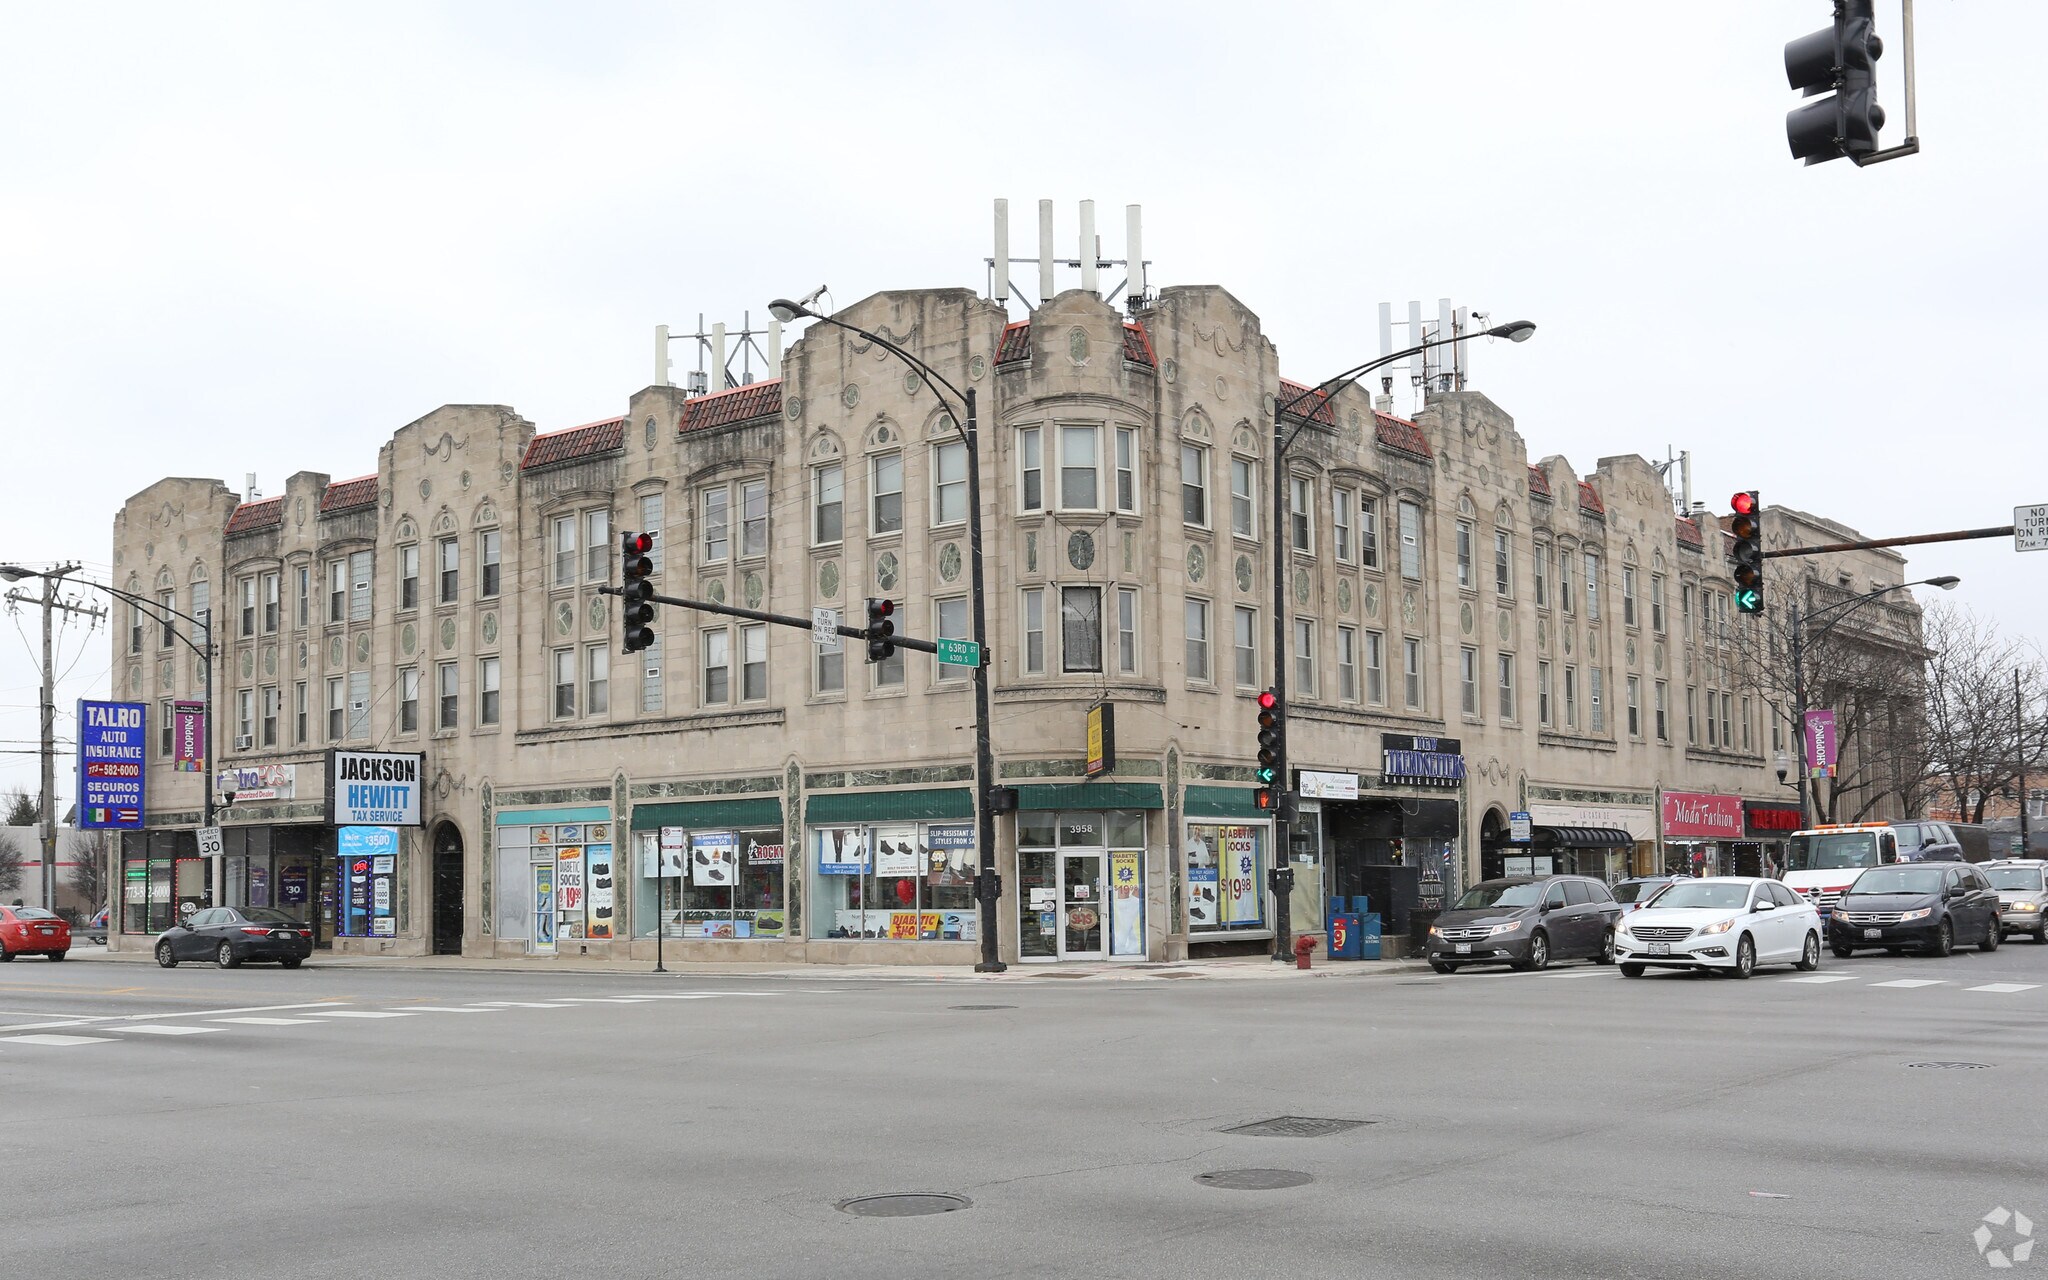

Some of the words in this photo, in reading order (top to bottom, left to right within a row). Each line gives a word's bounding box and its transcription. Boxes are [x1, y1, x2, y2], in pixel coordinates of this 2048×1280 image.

[2030, 508, 2045, 517] NO
[2018, 528, 2033, 538] ON
[820, 610, 829, 618] NO
[817, 617, 832, 626] TURN
[813, 624, 823, 633] ON
[824, 626, 835, 635] RED
[948, 643, 967, 654] 63RD
[970, 645, 977, 653] ST
[950, 653, 962, 662] 6300
[964, 655, 969, 663] S
[87, 706, 141, 729] TALRO
[100, 730, 128, 744] AUTO
[184, 715, 194, 758] SHOPPING
[1814, 724, 1826, 766] SHOPPING
[85, 744, 142, 759] INSURANCE
[340, 757, 416, 782] JACKSON
[87, 781, 140, 793] SEGUROS
[259, 788, 275, 798] Dealer
[89, 794, 105, 804] DE
[107, 794, 138, 805] AUTO
[348, 784, 410, 809] HEWITT
[352, 810, 368, 822] TAX
[369, 811, 403, 822] SERVICE
[1674, 799, 1700, 824] Moda
[1701, 802, 1734, 828] Fashion
[1751, 809, 1769, 830] TAE
[929, 829, 969, 838] SLIP-RESISTANT
[1070, 825, 1093, 834] 3958
[1219, 828, 1256, 839] DABETIC
[201, 834, 217, 842] LIMIT
[953, 837, 967, 845] FROM
[202, 841, 220, 853] 30
[757, 845, 784, 860] ROCKY
[559, 860, 580, 873] DIABETIC
[1243, 859, 1249, 867] 9
[1123, 869, 1129, 877] 9
[560, 874, 581, 887] SOCKS
[286, 885, 301, 894] $30
[892, 914, 935, 927] DIABTIC
[1071, 912, 1093, 925] SAS
[895, 925, 927, 937] SHOS
